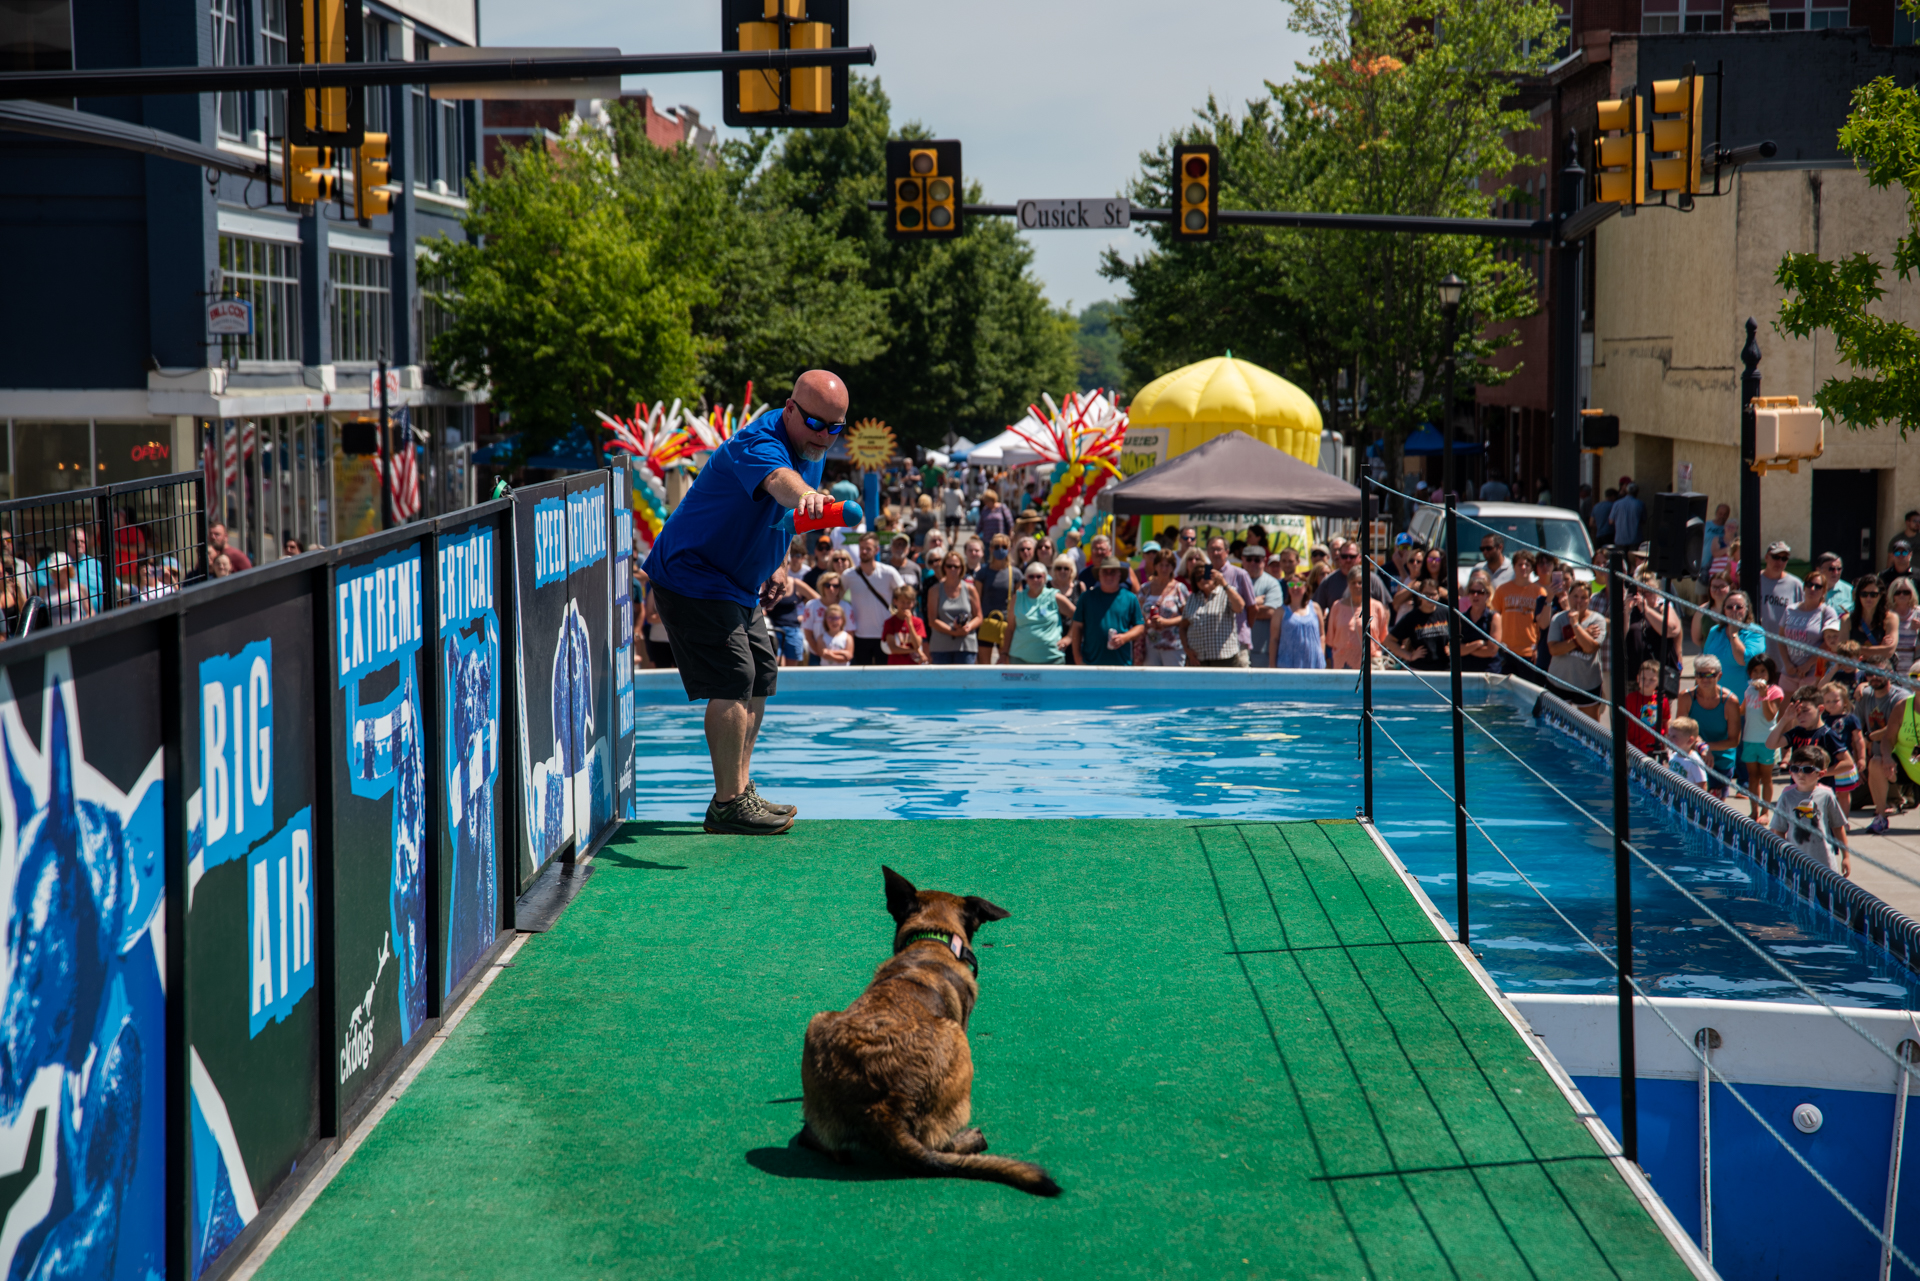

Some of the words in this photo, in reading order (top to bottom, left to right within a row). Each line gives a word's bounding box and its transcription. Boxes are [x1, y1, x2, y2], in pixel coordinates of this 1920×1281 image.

[1021, 200, 1090, 228] Cusick
[1103, 202, 1122, 226] St
[228, 303, 246, 320] COX
[131, 444, 170, 462] OPEN
[535, 509, 567, 580] SPEED
[567, 494, 605, 563] RETRIEVE
[339, 559, 421, 676] EXTREME
[1764, 595, 1789, 607] FORCE
[203, 655, 270, 846] BIG
[251, 829, 310, 1017] AIR
[905, 931, 949, 946] CAMILLE
[340, 1018, 374, 1085] ckdogs
